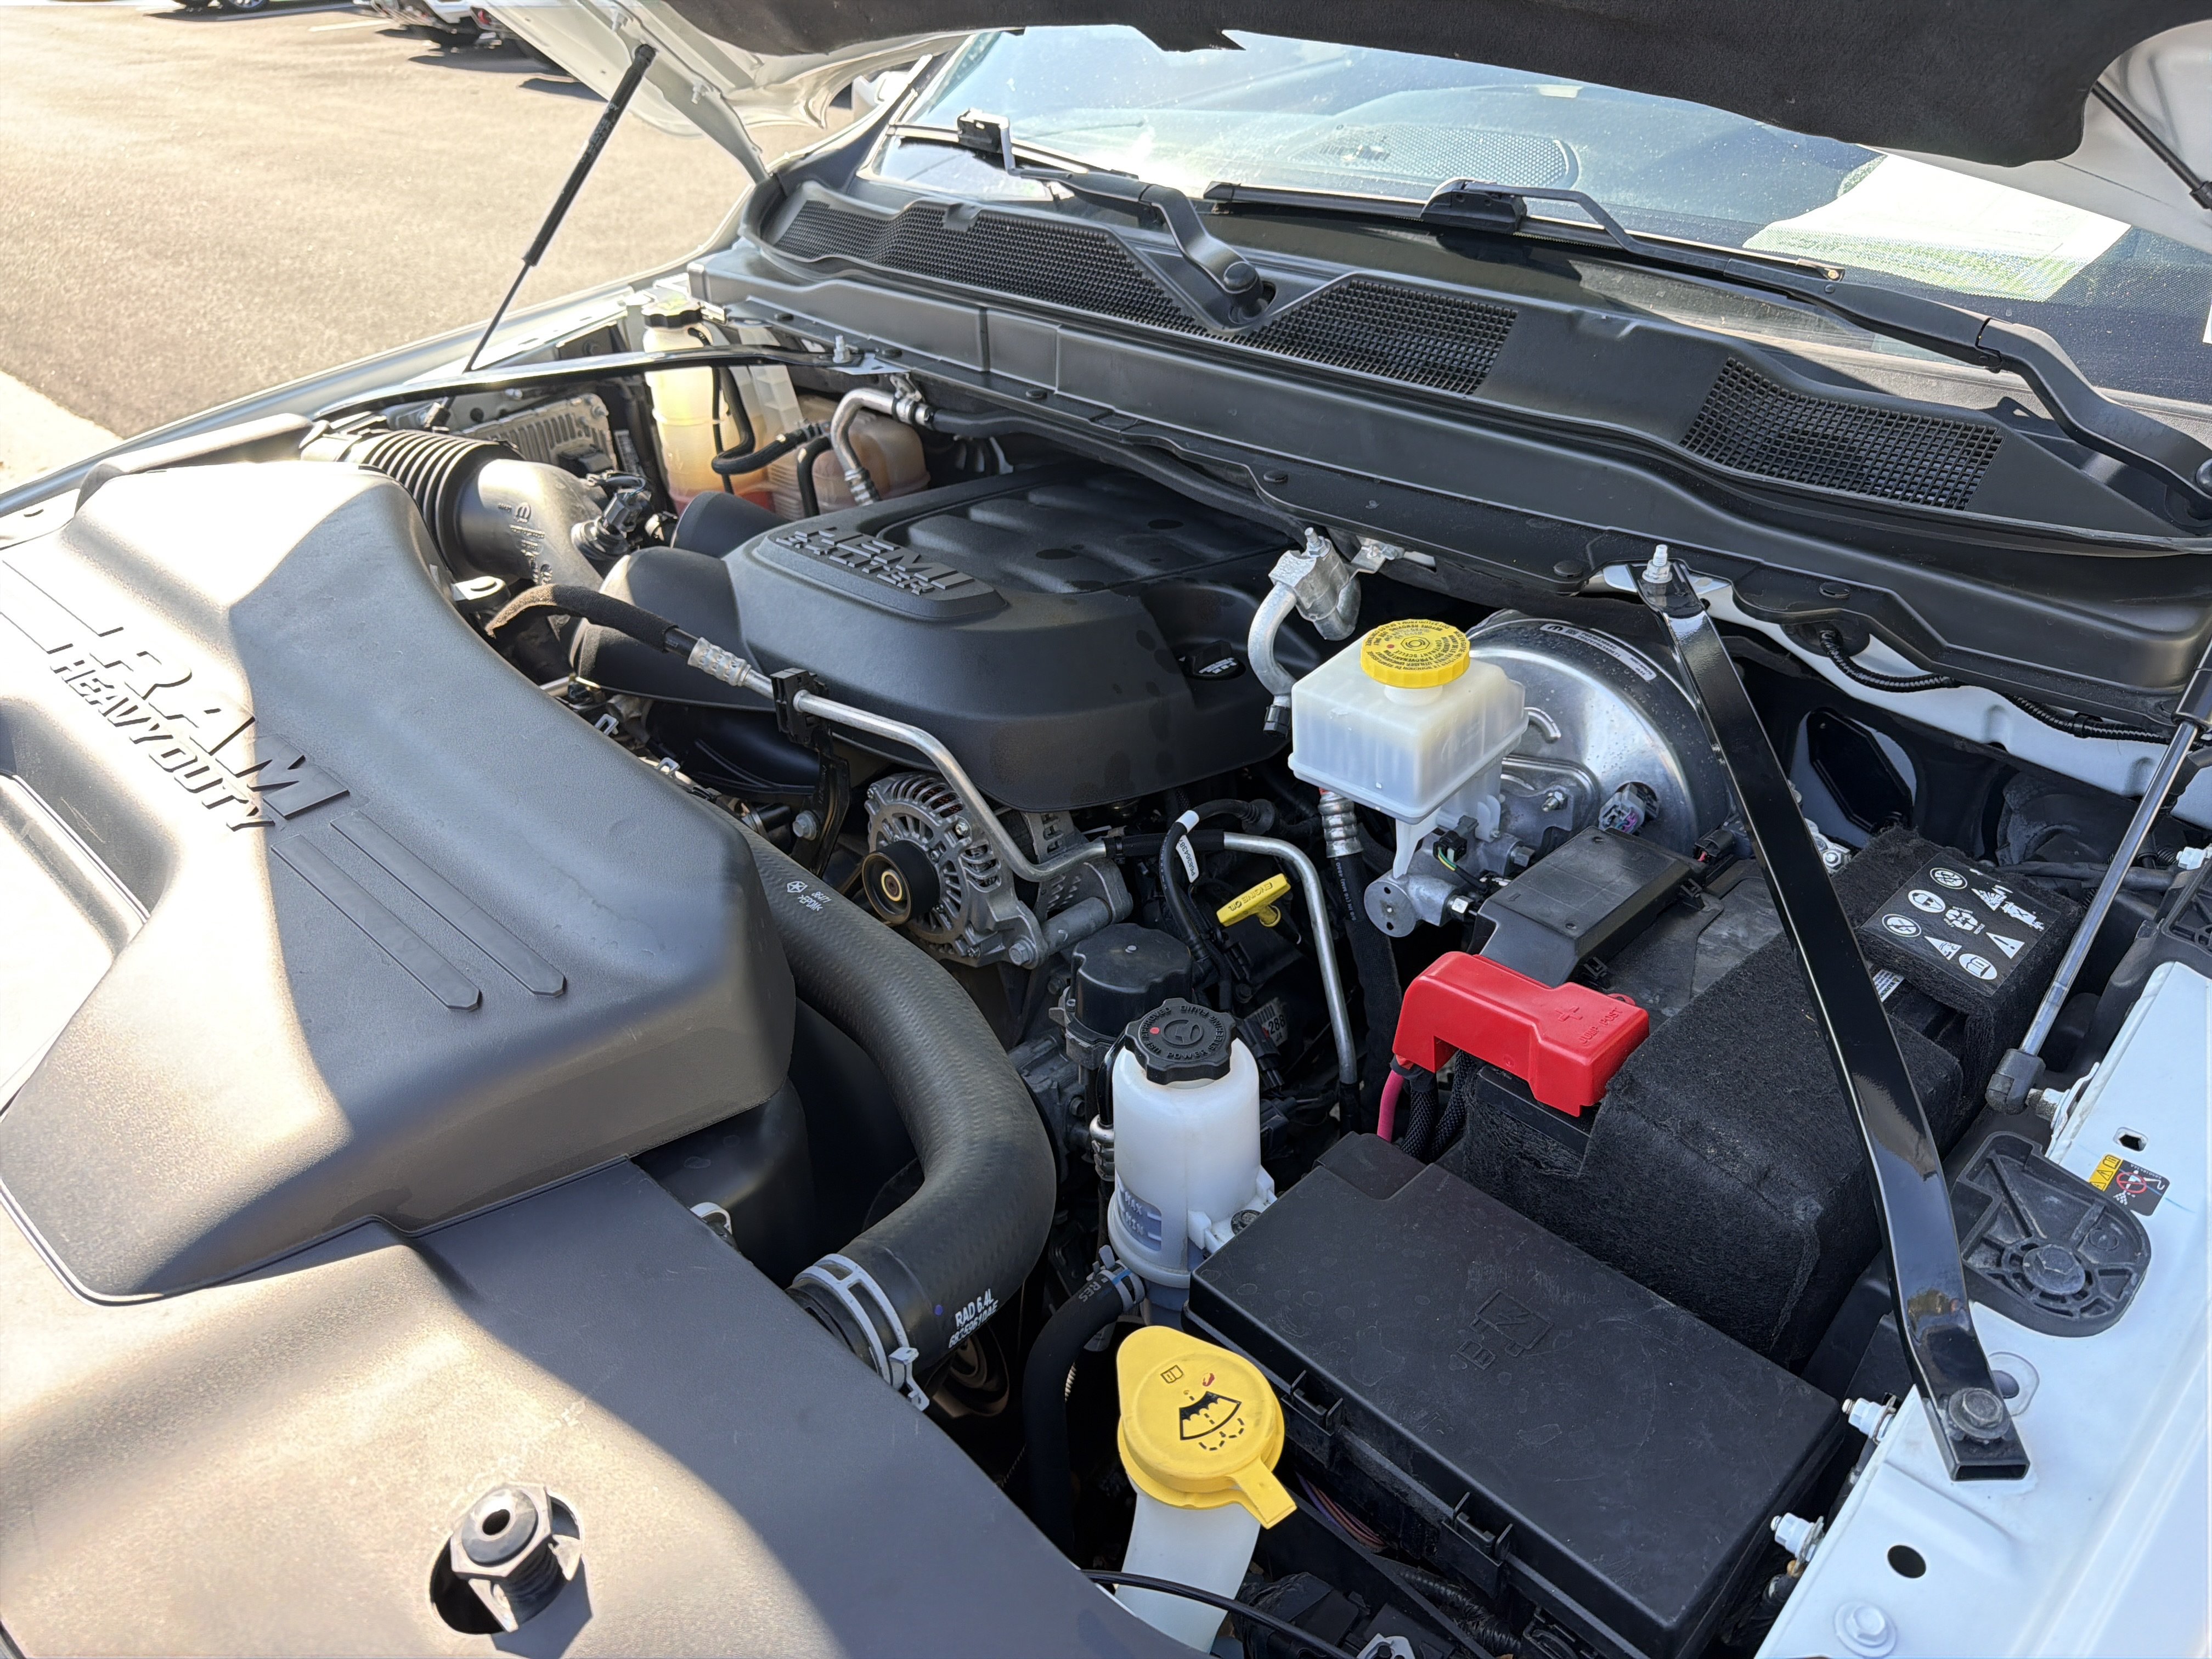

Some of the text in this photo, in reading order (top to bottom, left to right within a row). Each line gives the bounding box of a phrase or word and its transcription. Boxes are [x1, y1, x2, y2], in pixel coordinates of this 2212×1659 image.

[794, 527, 975, 590] HEMI
[89, 651, 350, 820] RAM
[1228, 881, 1274, 912] ENGINE OIL
[1141, 1006, 1172, 1054] USE APPROVED
[1166, 1005, 1226, 1060] POWER STEERING FLUID
[1268, 1014, 1285, 1035] 288
[1578, 1006, 1624, 1046] JUMP POST
[1125, 1190, 1143, 1216] MAX
[1125, 1211, 1144, 1236] MIN
[955, 1288, 994, 1328] RAD 6.4L
[1078, 1281, 1102, 1302] RES
